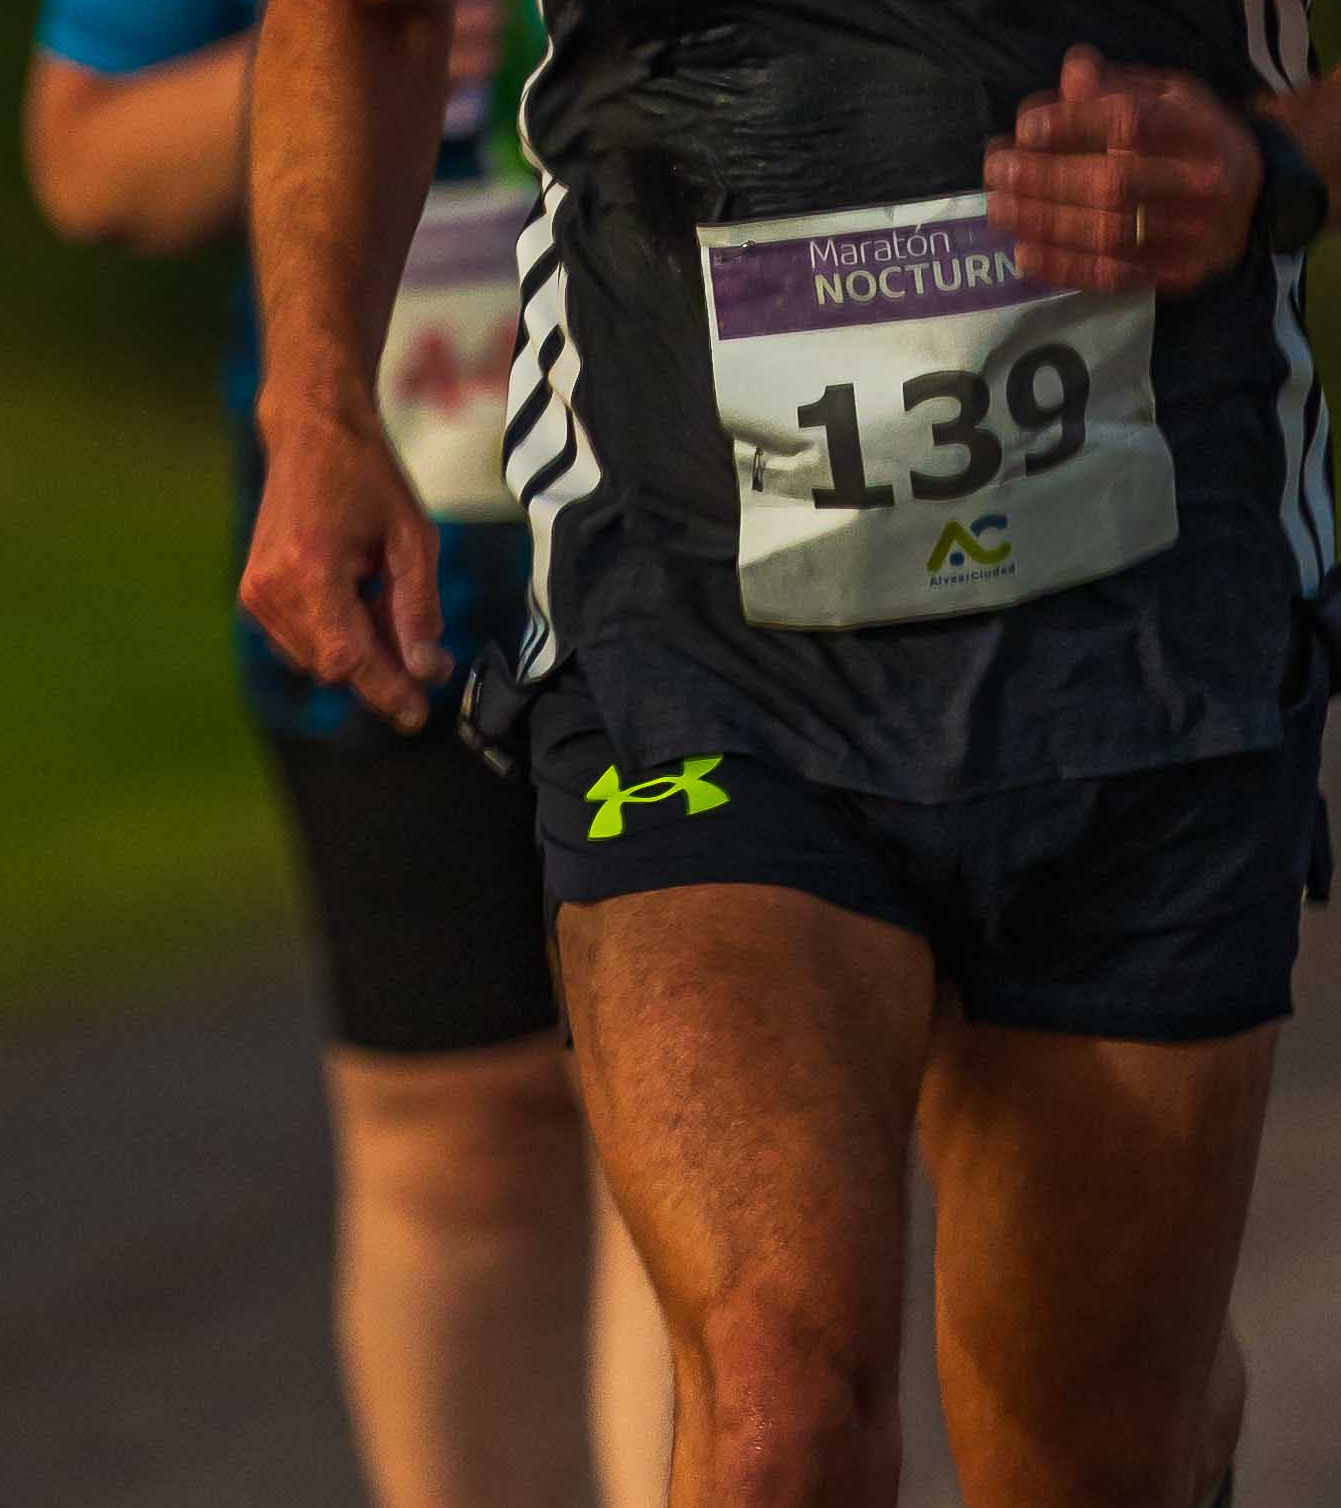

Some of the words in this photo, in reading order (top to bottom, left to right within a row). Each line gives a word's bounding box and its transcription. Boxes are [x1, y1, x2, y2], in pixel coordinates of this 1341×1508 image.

[810, 224, 951, 269] Maratón
[814, 250, 1025, 305] NOCTURN
[797, 342, 1090, 510] 139
